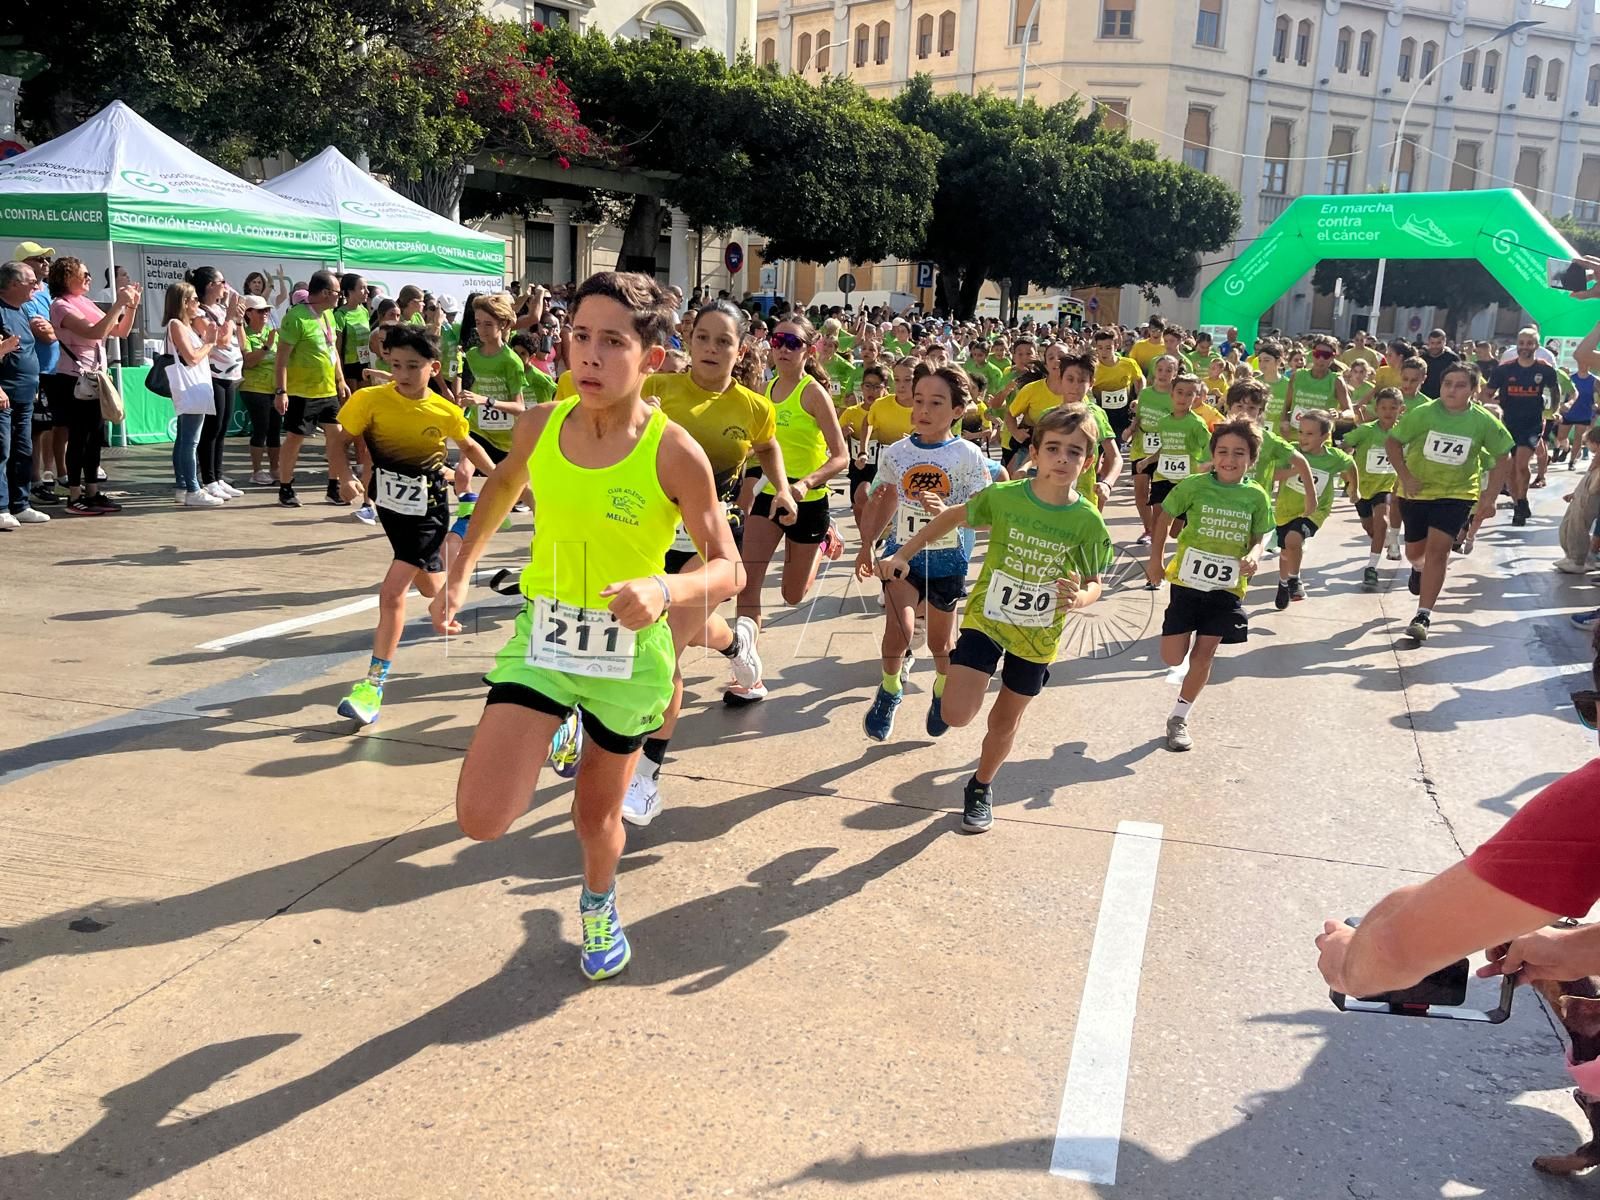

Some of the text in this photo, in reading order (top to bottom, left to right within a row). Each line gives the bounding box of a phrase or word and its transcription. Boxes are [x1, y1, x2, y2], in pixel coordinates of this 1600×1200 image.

[4, 208, 46, 220] CONTRA
[47, 210, 60, 221] EL
[60, 207, 104, 222] CÁNCER
[1321, 203, 1393, 214] En marcha
[113, 212, 186, 231] ASOCIACIÓN
[187, 219, 244, 235] ESPAÑOLA
[245, 225, 287, 240] CONTRA
[1317, 216, 1362, 227] contra
[1317, 229, 1381, 240] el cáncer
[344, 237, 396, 250] ASOCIACIÓN
[397, 240, 437, 254] ESPAÑOLA
[437, 245, 467, 258] CONTRA
[476, 250, 504, 263] CÁNCER
[920, 264, 931, 285] P
[1105, 394, 1125, 403] 216
[482, 409, 508, 421] 201
[1433, 440, 1464, 456] 174
[1165, 461, 1186, 472] 164
[385, 481, 422, 501] 172
[606, 512, 640, 526] MELILLA
[1202, 505, 1252, 520] En marcha
[1200, 516, 1237, 529] contra
[1009, 528, 1024, 540] En
[1198, 525, 1248, 542] cáncer
[1007, 543, 1053, 565] contra
[1004, 556, 1063, 578] cáncer
[1192, 560, 1233, 582] 103
[1001, 586, 1050, 611] 130
[545, 617, 619, 653] 211
